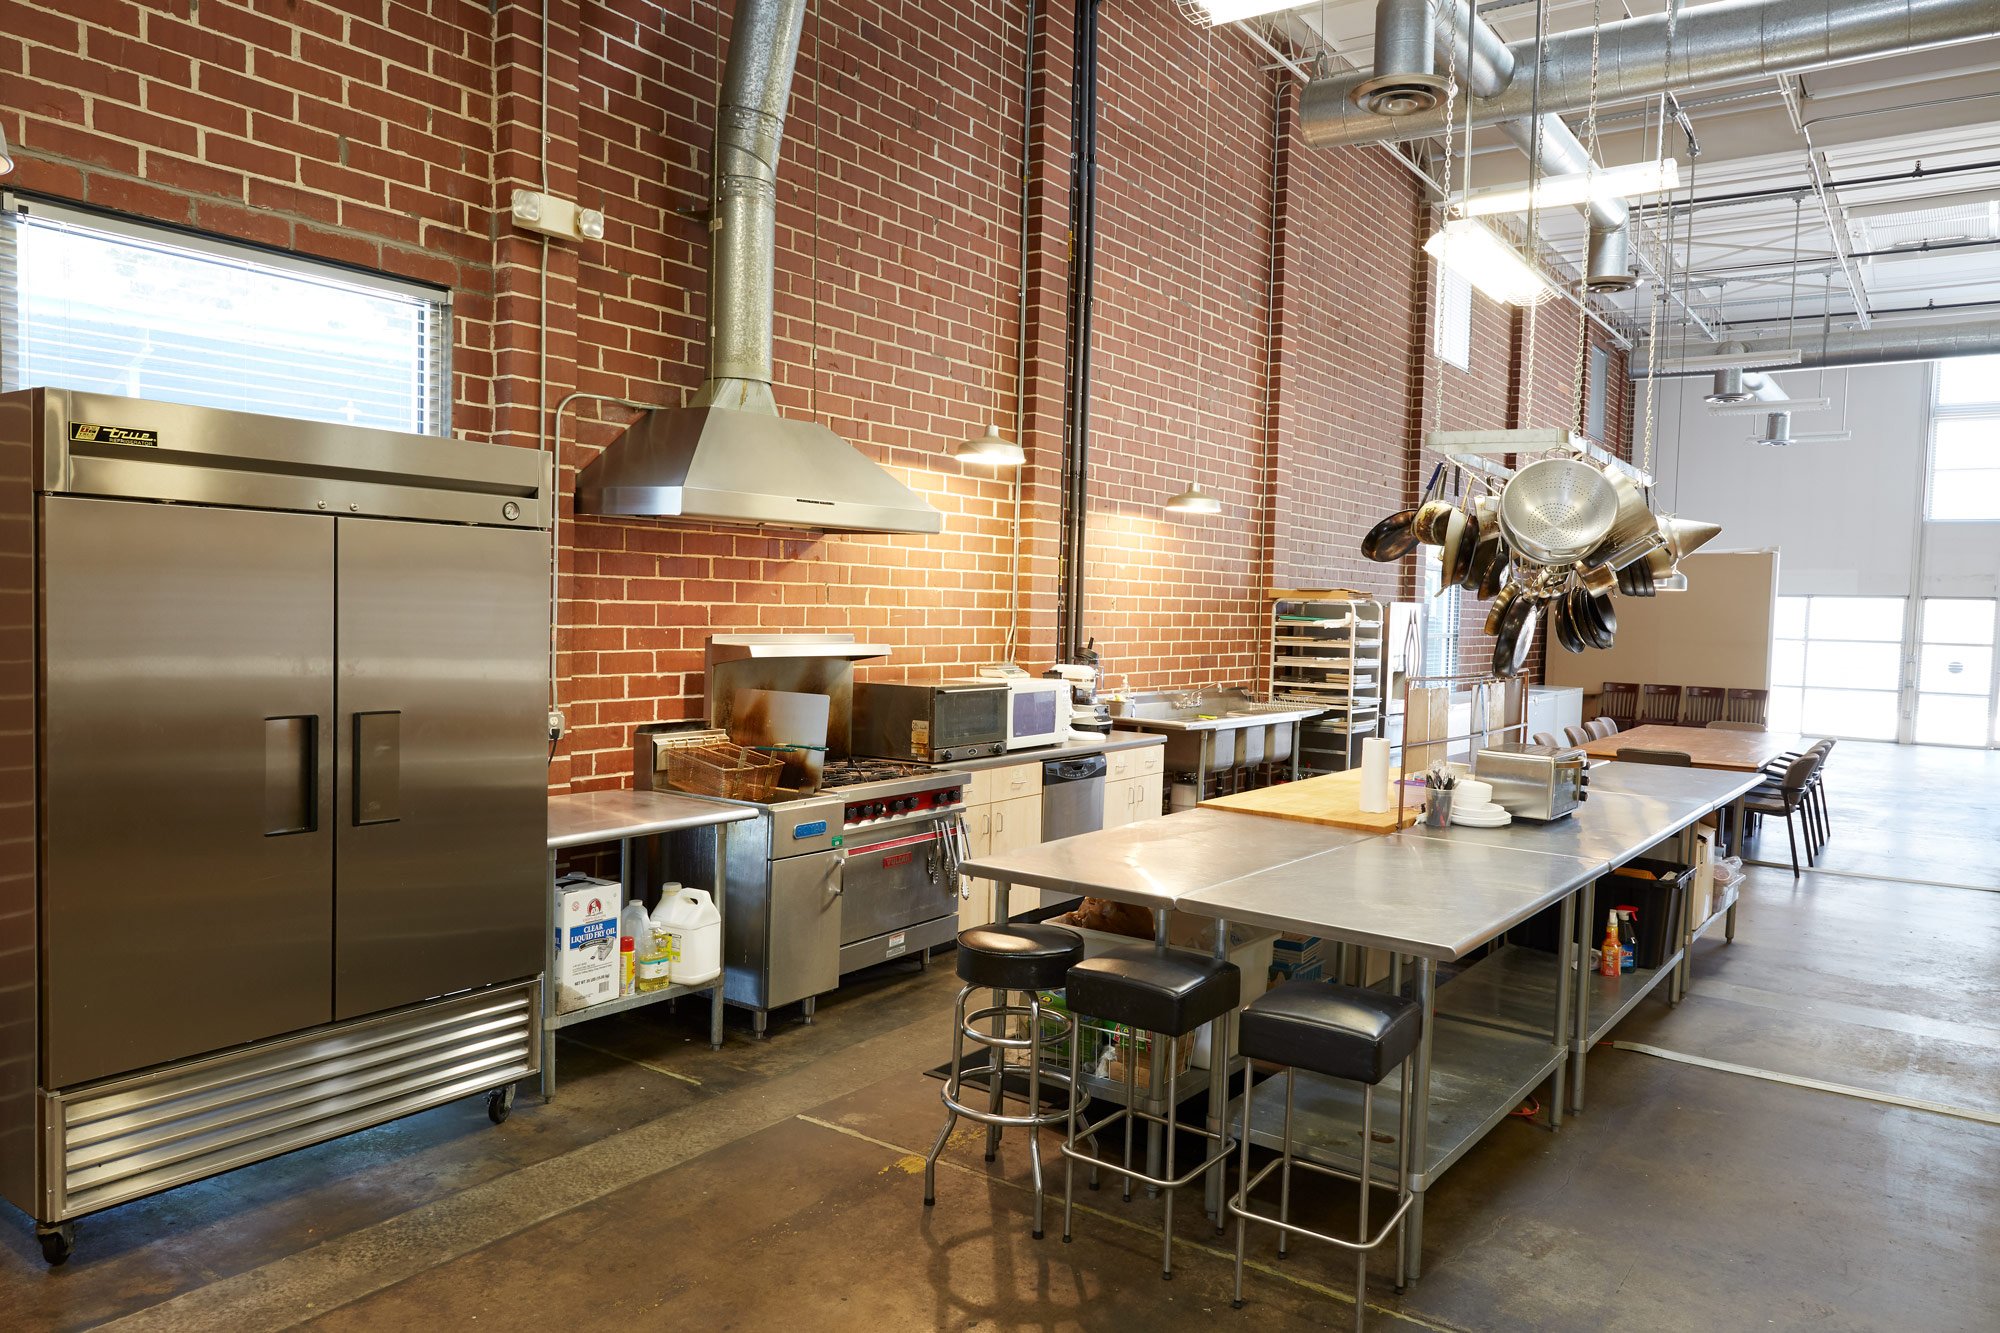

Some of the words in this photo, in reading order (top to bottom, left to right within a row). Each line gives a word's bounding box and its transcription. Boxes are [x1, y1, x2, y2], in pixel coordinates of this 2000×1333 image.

[109, 438, 153, 446] REFRIGERATOR
[583, 923, 604, 933] CLEAR
[571, 933, 594, 944] LIQUID
[594, 930, 606, 939] FRY
[605, 928, 617, 936] OIL
